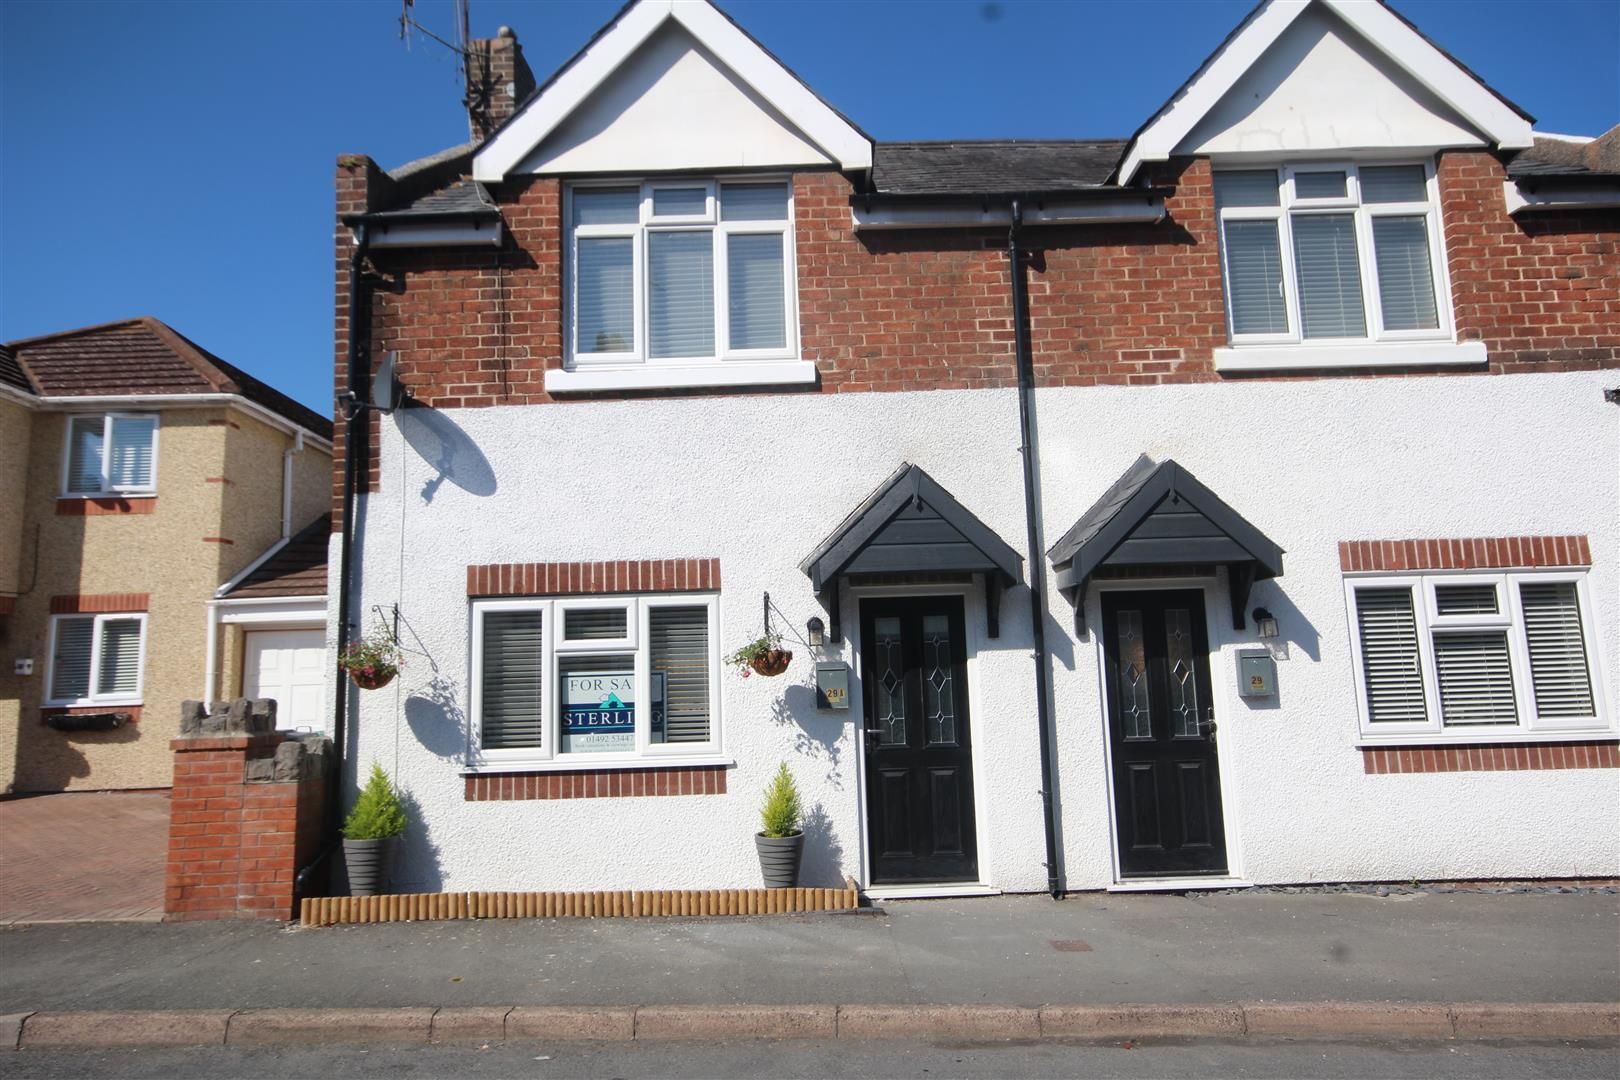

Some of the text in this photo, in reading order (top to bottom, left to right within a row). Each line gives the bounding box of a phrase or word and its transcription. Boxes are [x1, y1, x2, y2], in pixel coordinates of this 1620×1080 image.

[570, 678, 632, 692] FOR SA
[563, 711, 662, 726] STERLIG
[586, 735, 609, 744] 01492
